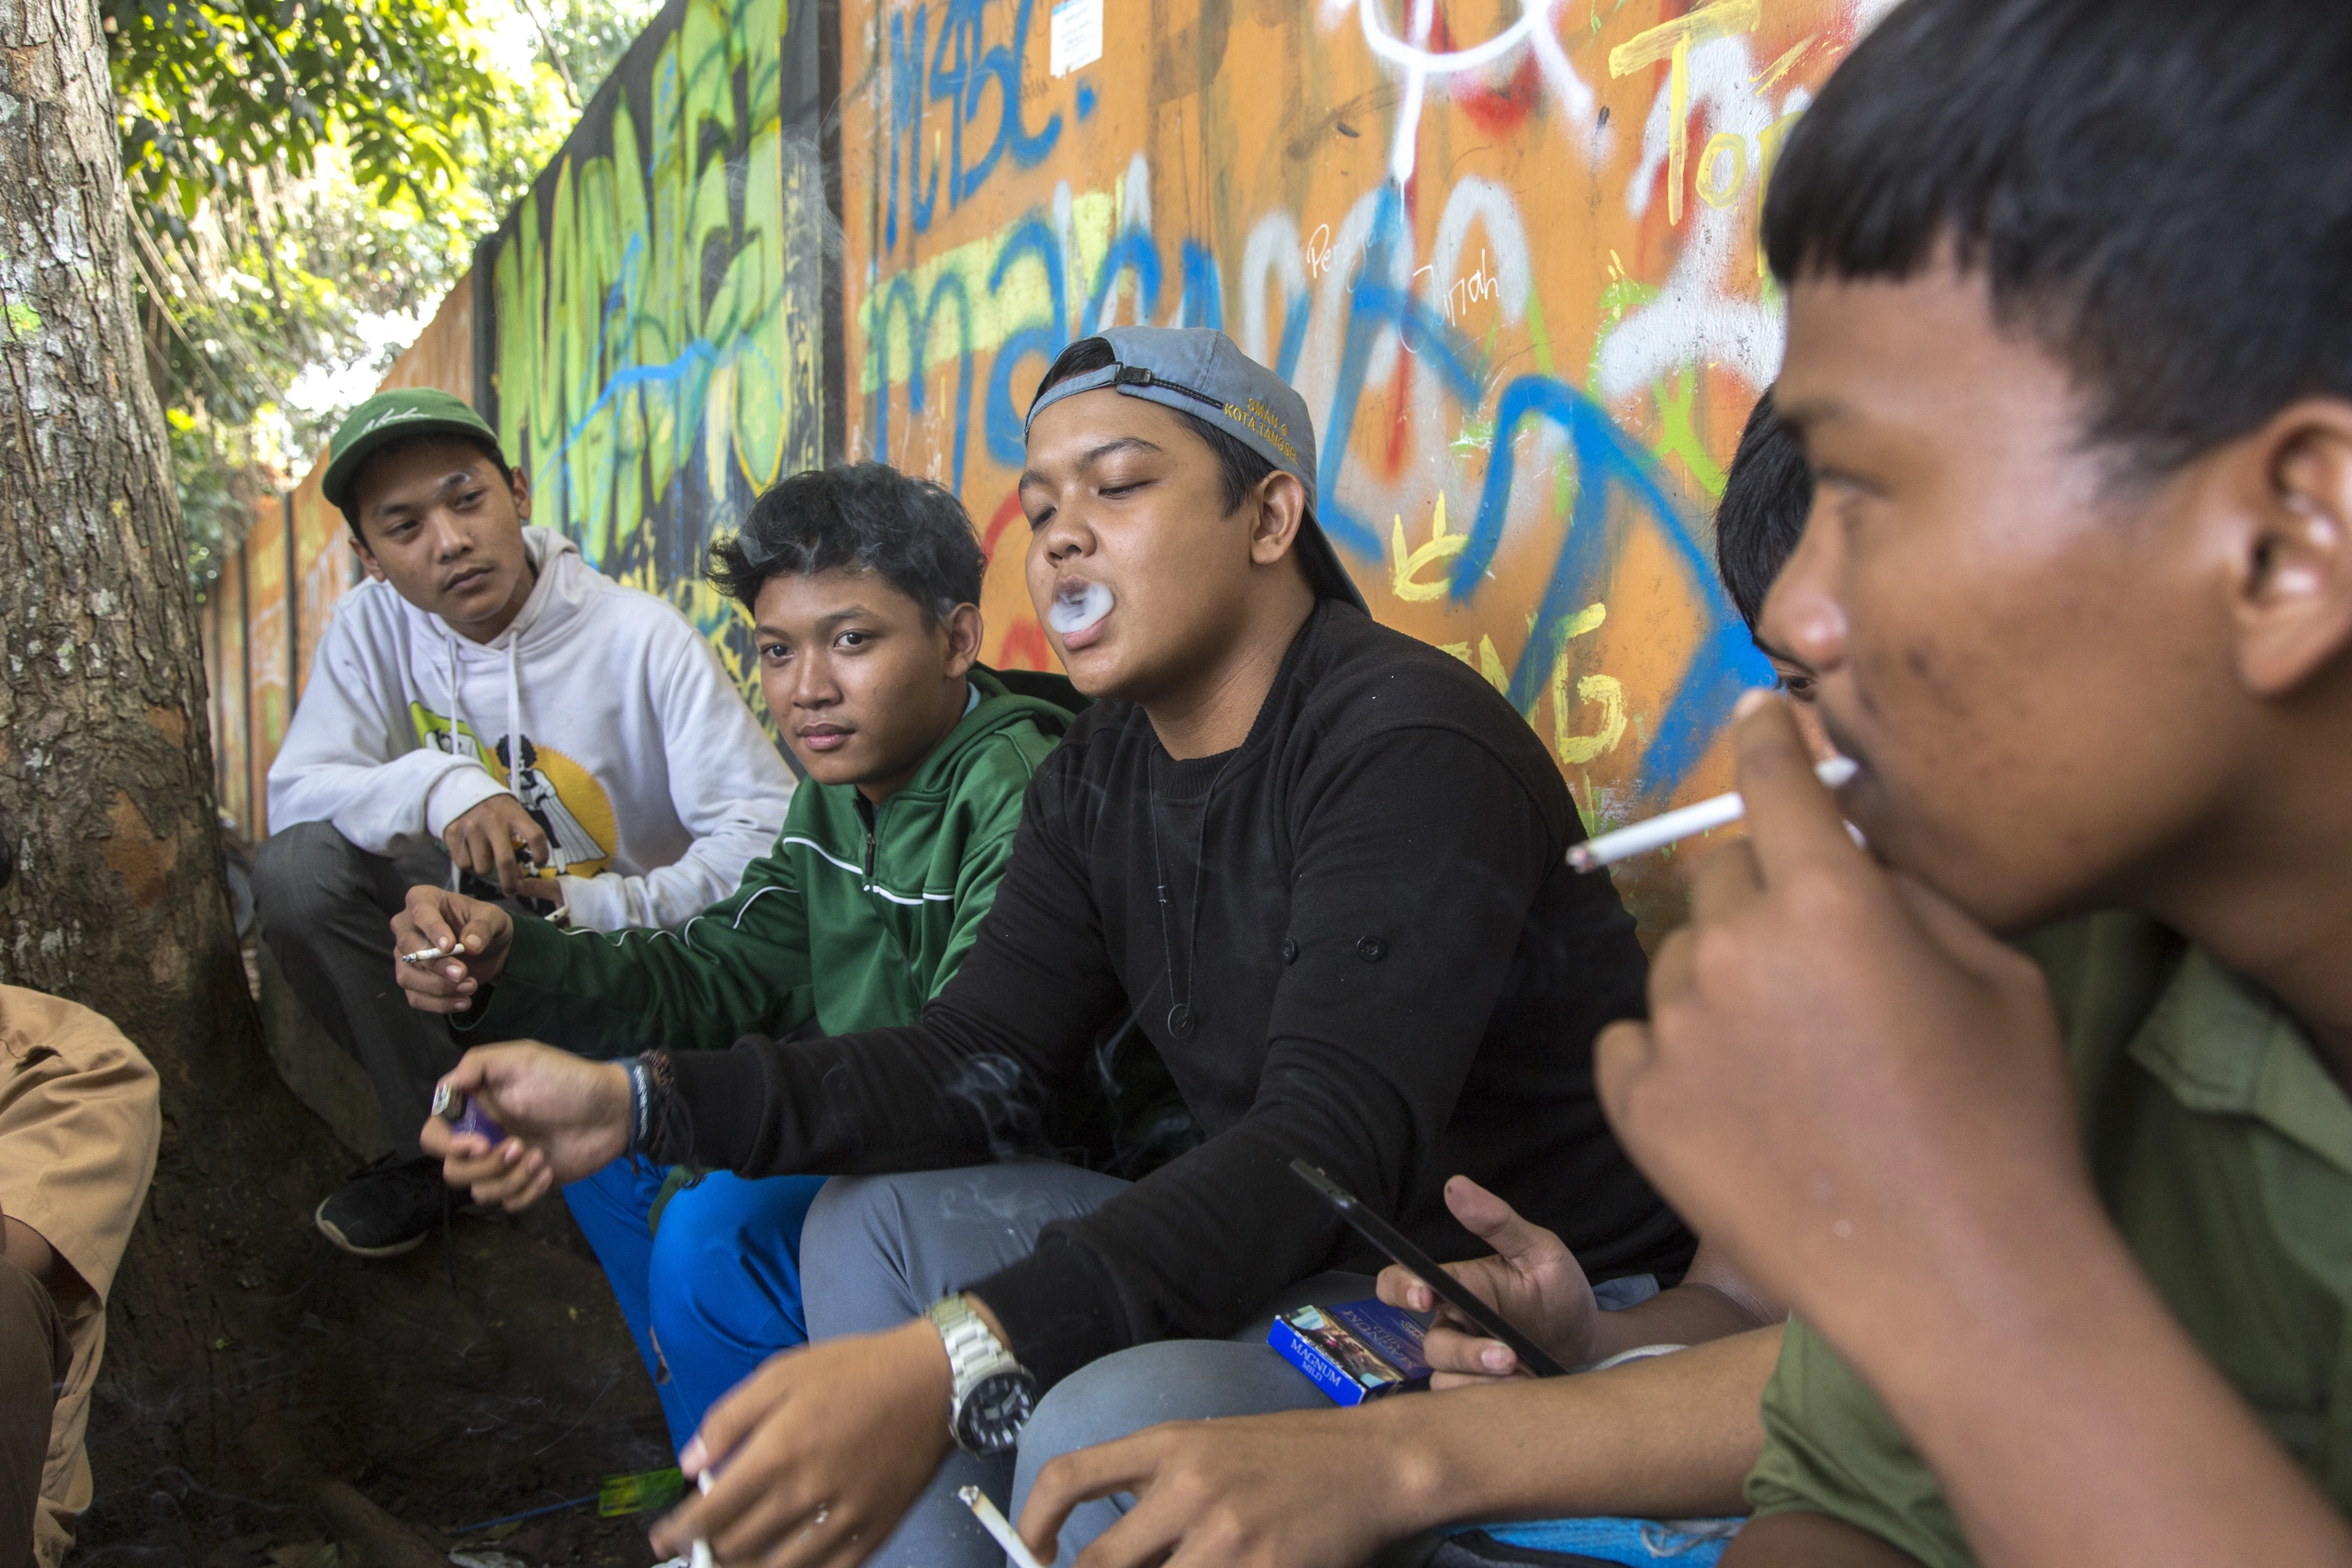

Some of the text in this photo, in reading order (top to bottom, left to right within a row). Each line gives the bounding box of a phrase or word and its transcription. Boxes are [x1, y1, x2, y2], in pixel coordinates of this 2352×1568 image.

[1248, 398, 1279, 429] SMAN
[1290, 1337, 1342, 1387] MAGNUM
[1301, 1359, 1323, 1382] MILD
